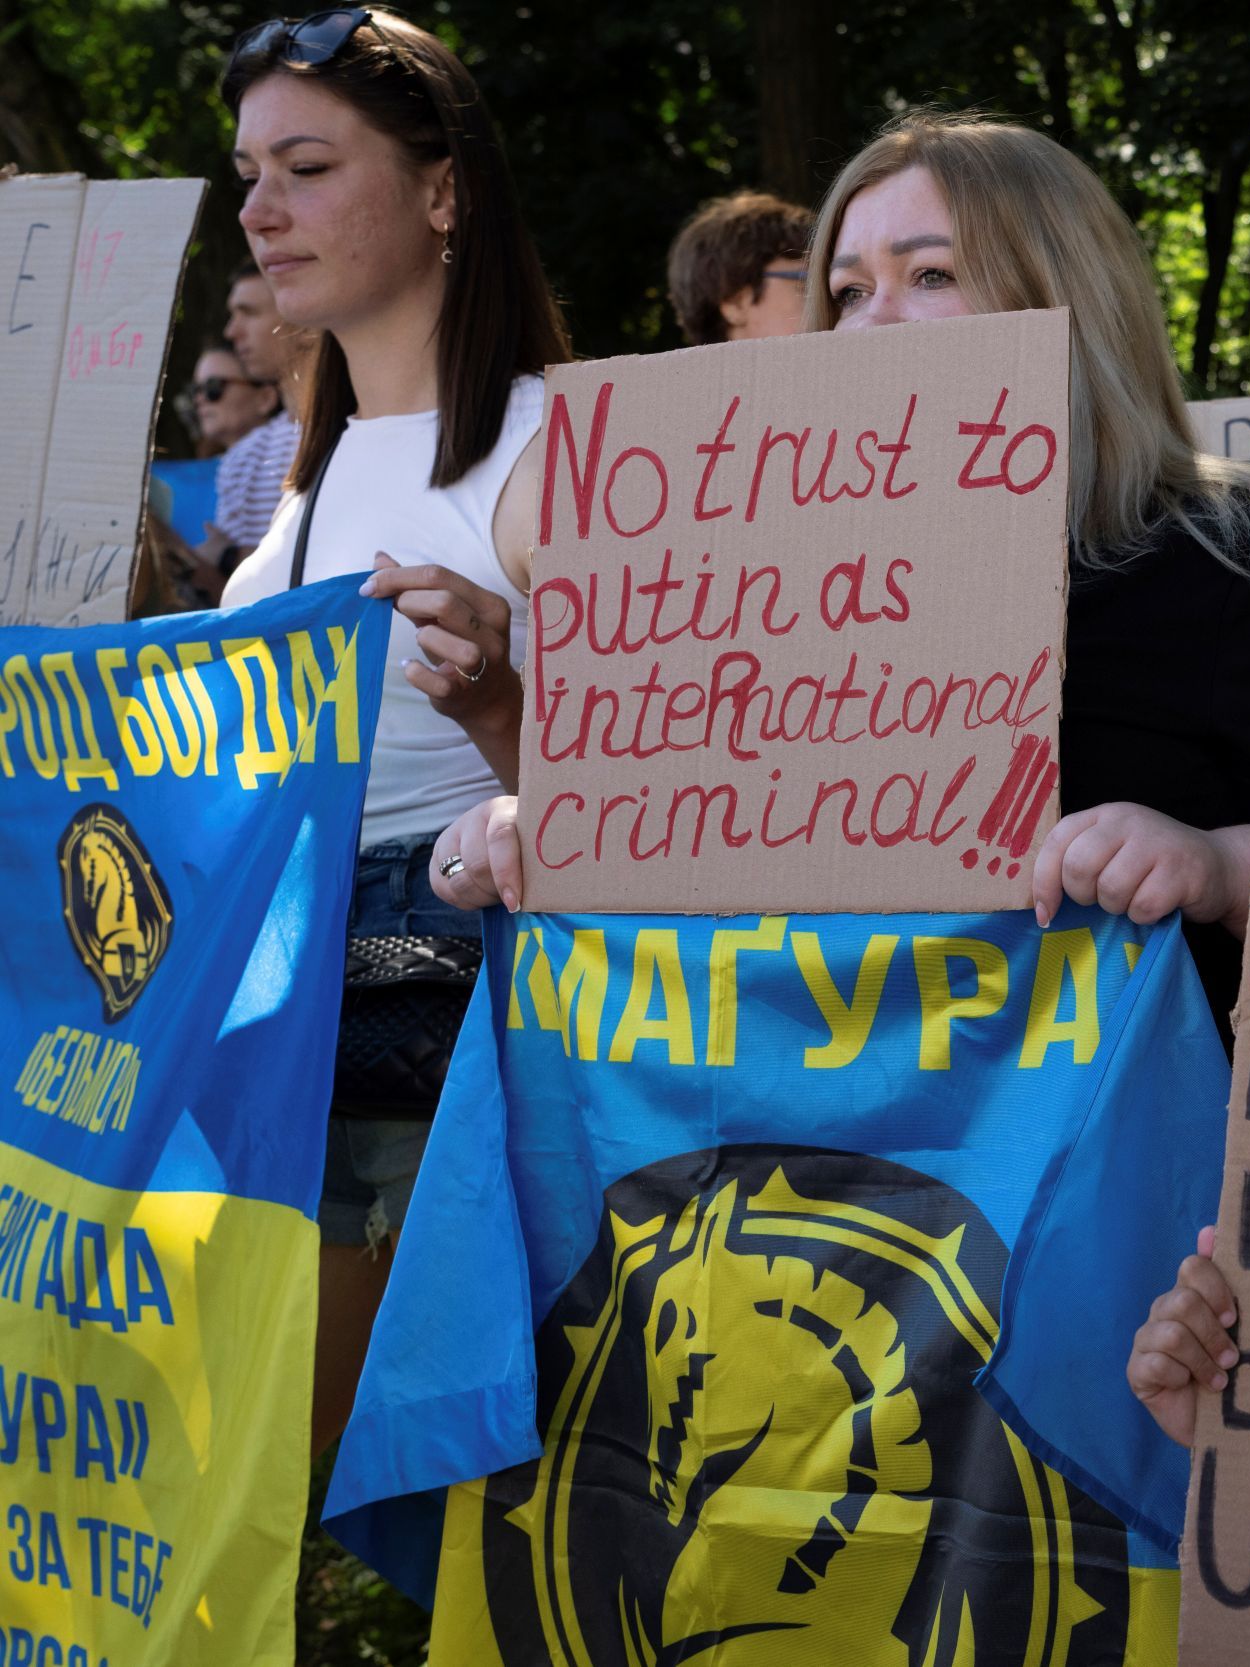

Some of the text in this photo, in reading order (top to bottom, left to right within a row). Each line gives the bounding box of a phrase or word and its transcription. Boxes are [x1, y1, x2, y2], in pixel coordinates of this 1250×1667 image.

[540, 383, 1057, 545] No trust to
[820, 553, 914, 631] as
[7, 1503, 173, 1630] ЗА ТЕБЕ
